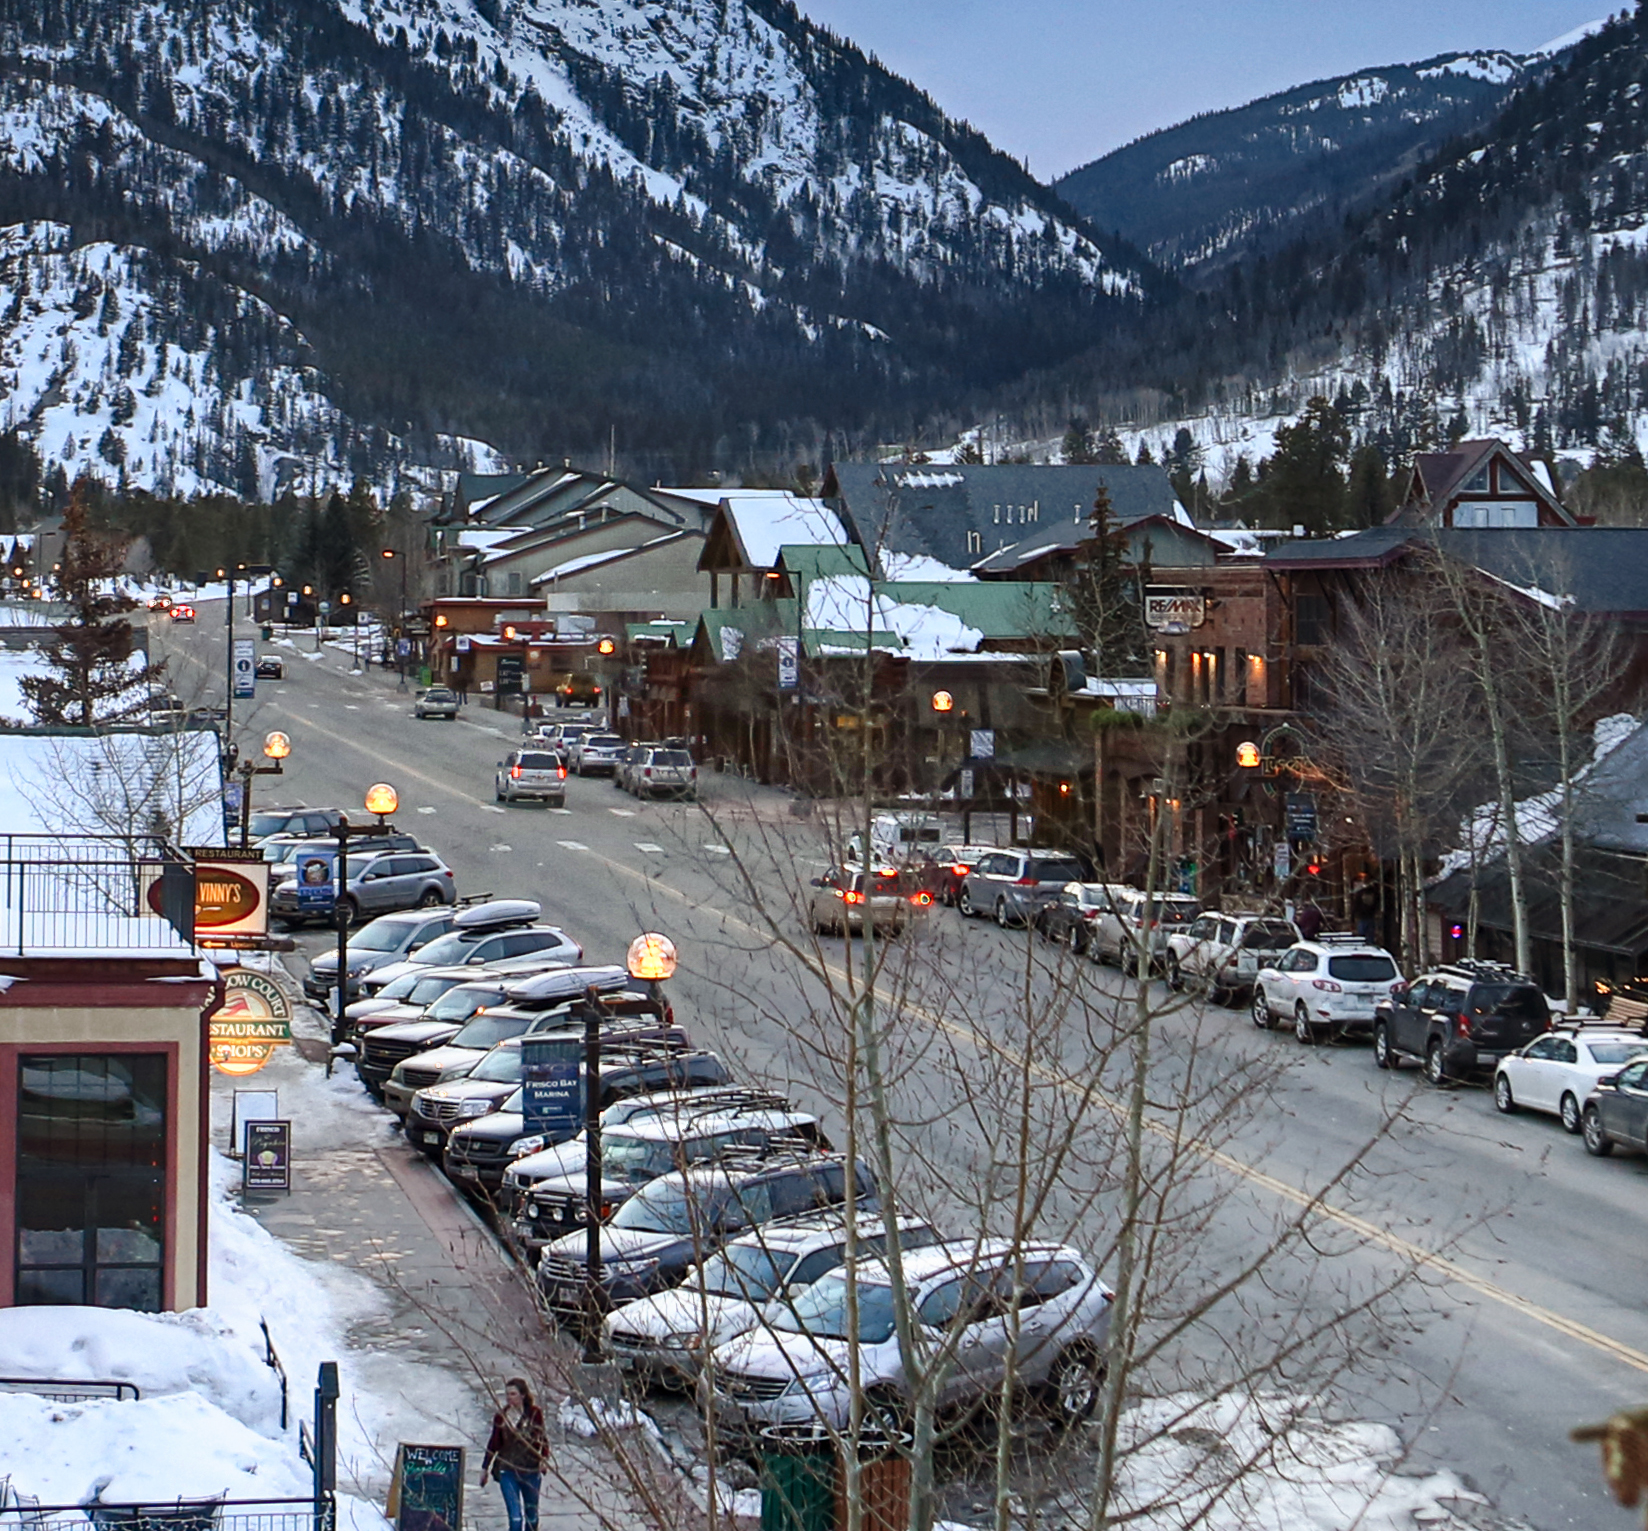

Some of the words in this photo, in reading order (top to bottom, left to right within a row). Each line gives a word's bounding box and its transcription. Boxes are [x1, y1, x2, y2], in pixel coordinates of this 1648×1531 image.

[1149, 599, 1202, 613] RE/MAX
[194, 848, 261, 859] RESTAURANT
[199, 882, 242, 903] VINNY'S
[251, 977, 286, 1017] COURT
[215, 1044, 264, 1058] SHOPS
[405, 1446, 460, 1463] WELCOME
